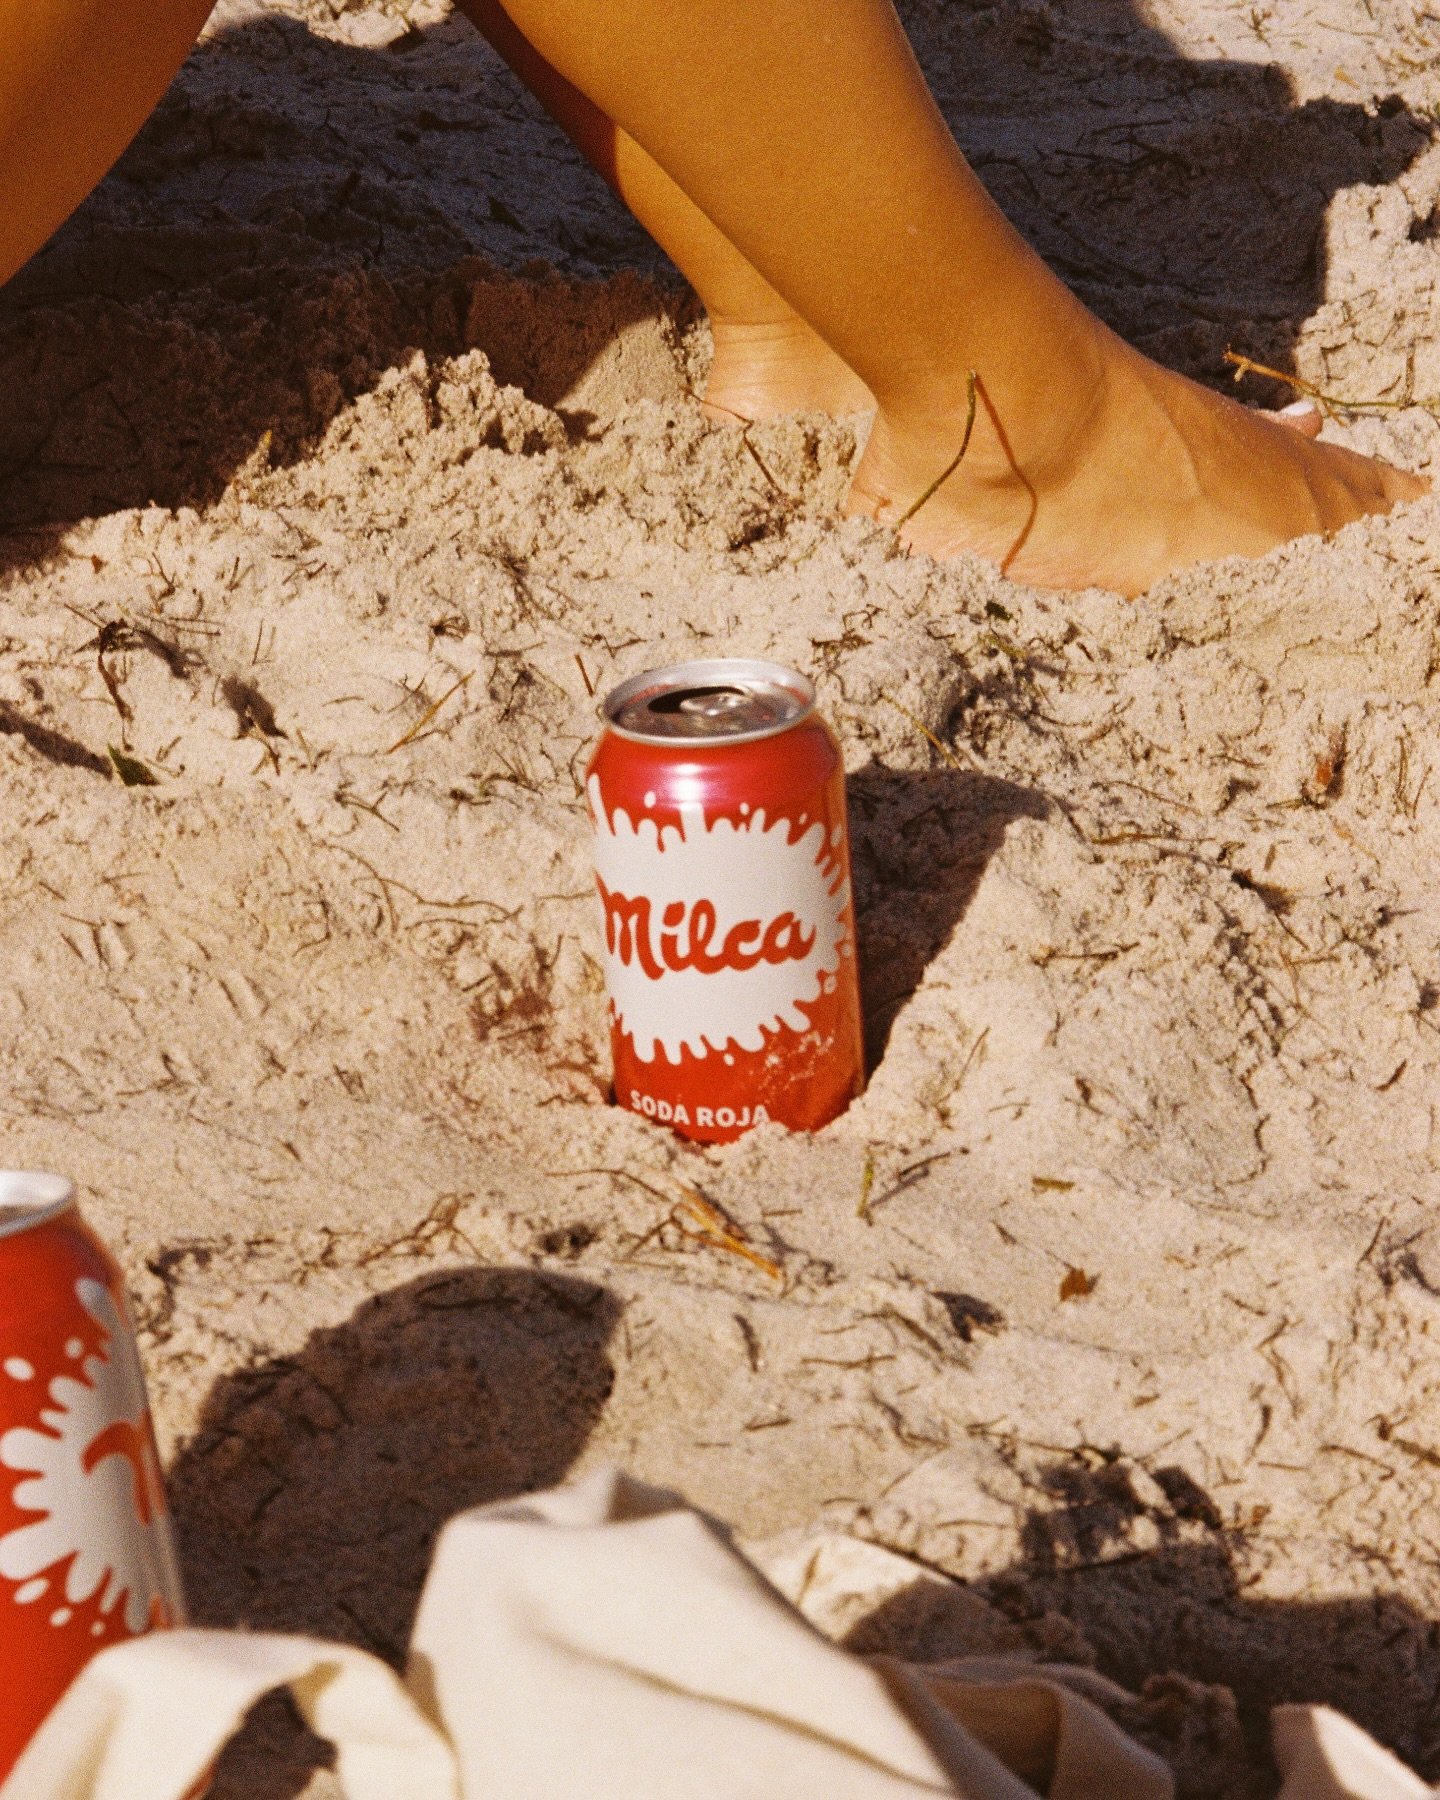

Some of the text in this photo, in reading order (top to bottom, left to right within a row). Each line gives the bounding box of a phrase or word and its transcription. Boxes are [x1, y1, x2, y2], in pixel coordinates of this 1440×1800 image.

[595, 869, 817, 981] Milca
[630, 1089, 771, 1128] SODA ROJA
